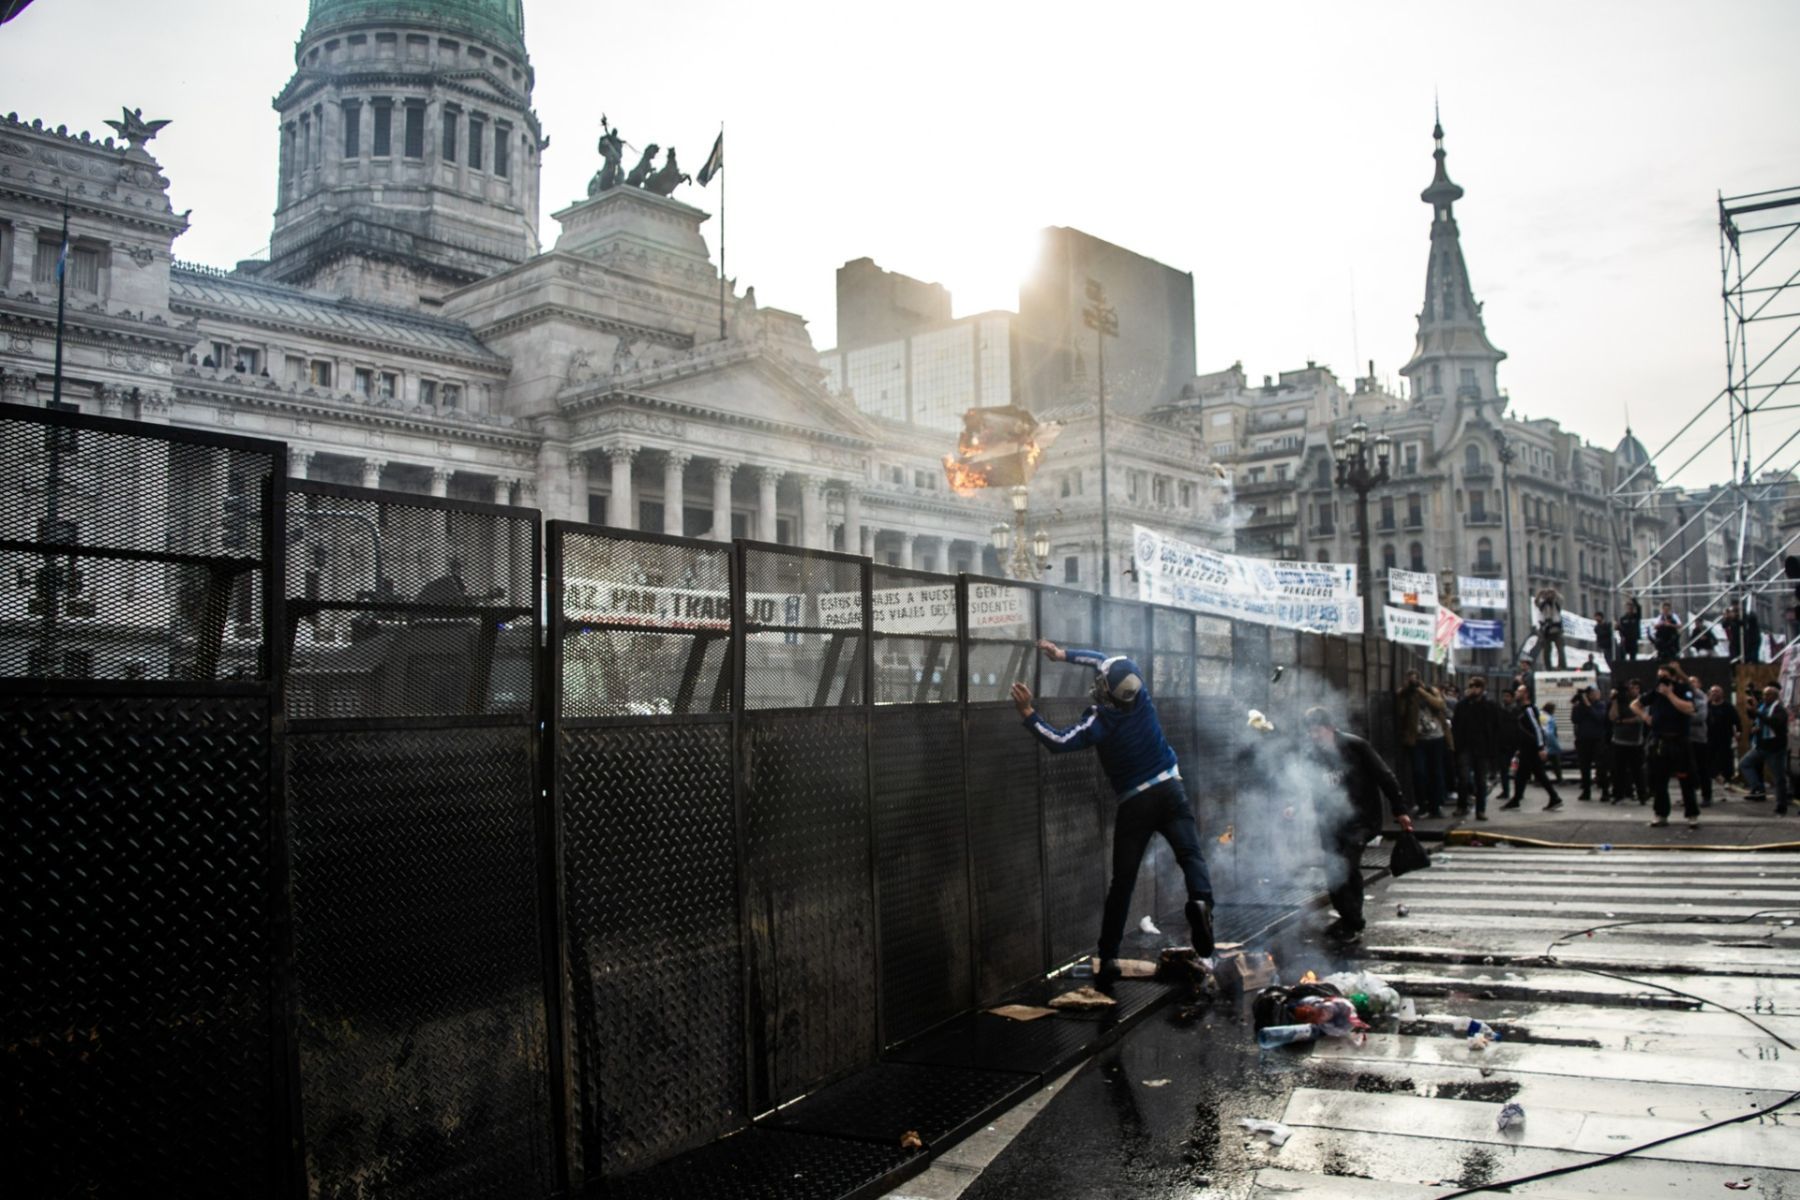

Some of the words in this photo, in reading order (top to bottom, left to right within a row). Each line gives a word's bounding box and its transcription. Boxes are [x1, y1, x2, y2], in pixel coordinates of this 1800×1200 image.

[907, 592, 914, 604] A
[671, 593, 775, 623] TRABJO
[889, 605, 925, 620] VIAJES
